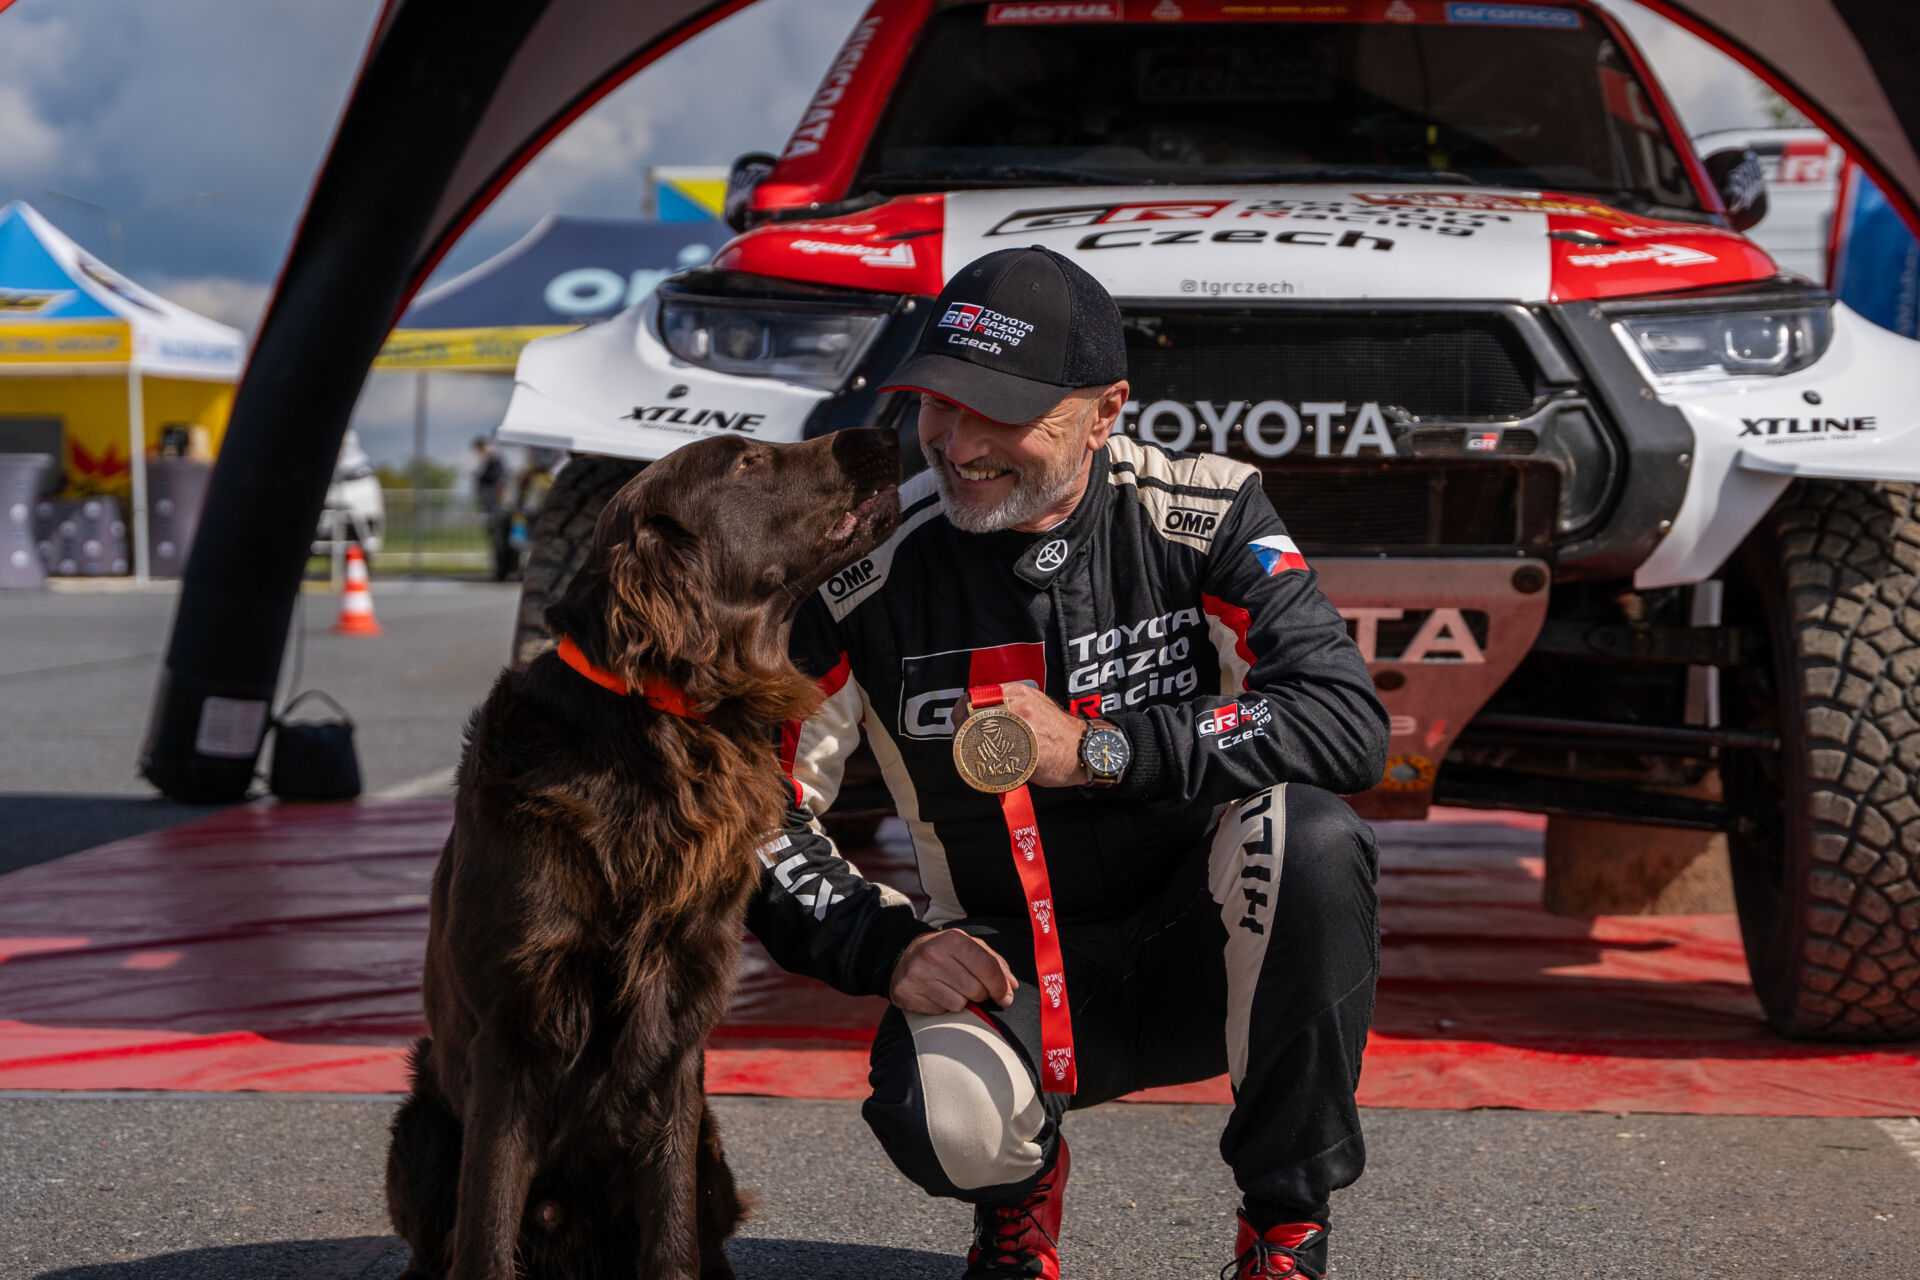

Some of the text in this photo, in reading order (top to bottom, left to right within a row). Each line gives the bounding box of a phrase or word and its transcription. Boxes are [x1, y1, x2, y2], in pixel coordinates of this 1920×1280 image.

[998, 4, 1114, 19] MOTUL
[1453, 7, 1571, 23] aramco
[1076, 227, 1396, 252] Czech
[939, 310, 976, 328] GR
[978, 317, 1026, 338] GAZOO
[984, 308, 1035, 333] TOYOTA
[947, 333, 1003, 356] Czech
[973, 324, 1021, 347] Racing
[619, 406, 767, 433] XTLINE
[1113, 400, 1398, 459] OYOTA
[1738, 416, 1877, 437] XTLINE
[1165, 510, 1216, 535] OMP
[827, 558, 874, 597] OMP
[955, 721, 971, 745] DAKAR
[969, 709, 991, 723] SAUDI
[992, 709, 1020, 721] ARABIA
[1198, 712, 1238, 735] GR
[1217, 727, 1270, 750] Czec
[976, 756, 1025, 779] DAKAR
[989, 780, 1019, 792] JANUARY
[1238, 783, 1273, 935] HILU
